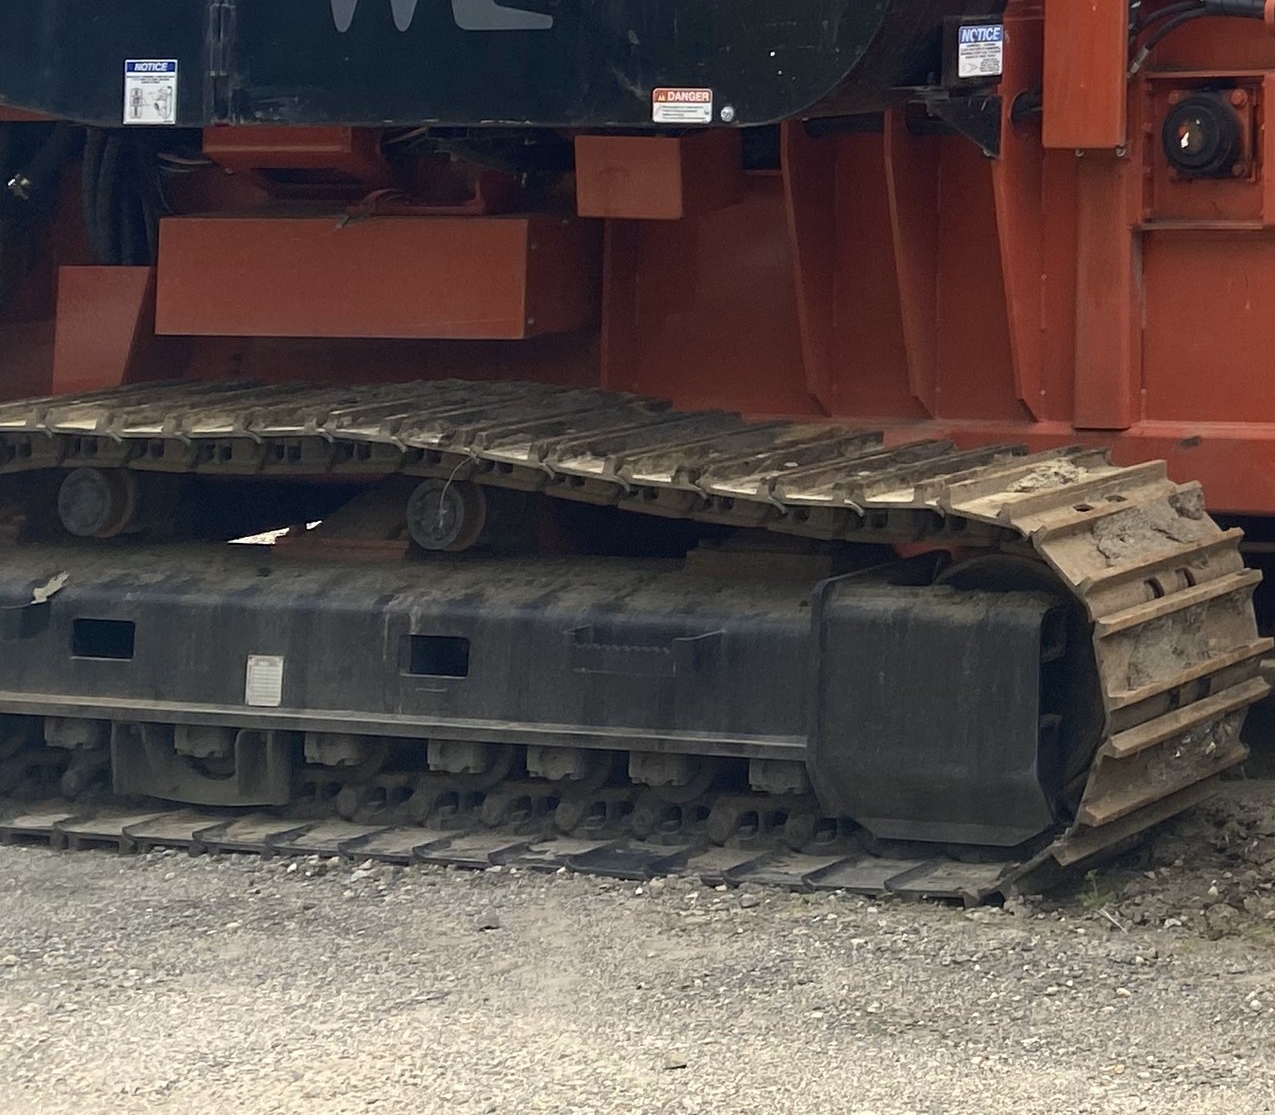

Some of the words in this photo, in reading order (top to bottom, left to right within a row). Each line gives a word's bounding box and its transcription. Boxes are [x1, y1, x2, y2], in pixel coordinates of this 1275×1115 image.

[961, 27, 1001, 42] NOTICE
[134, 62, 168, 72] NOTICE
[667, 91, 710, 101] DANGER
